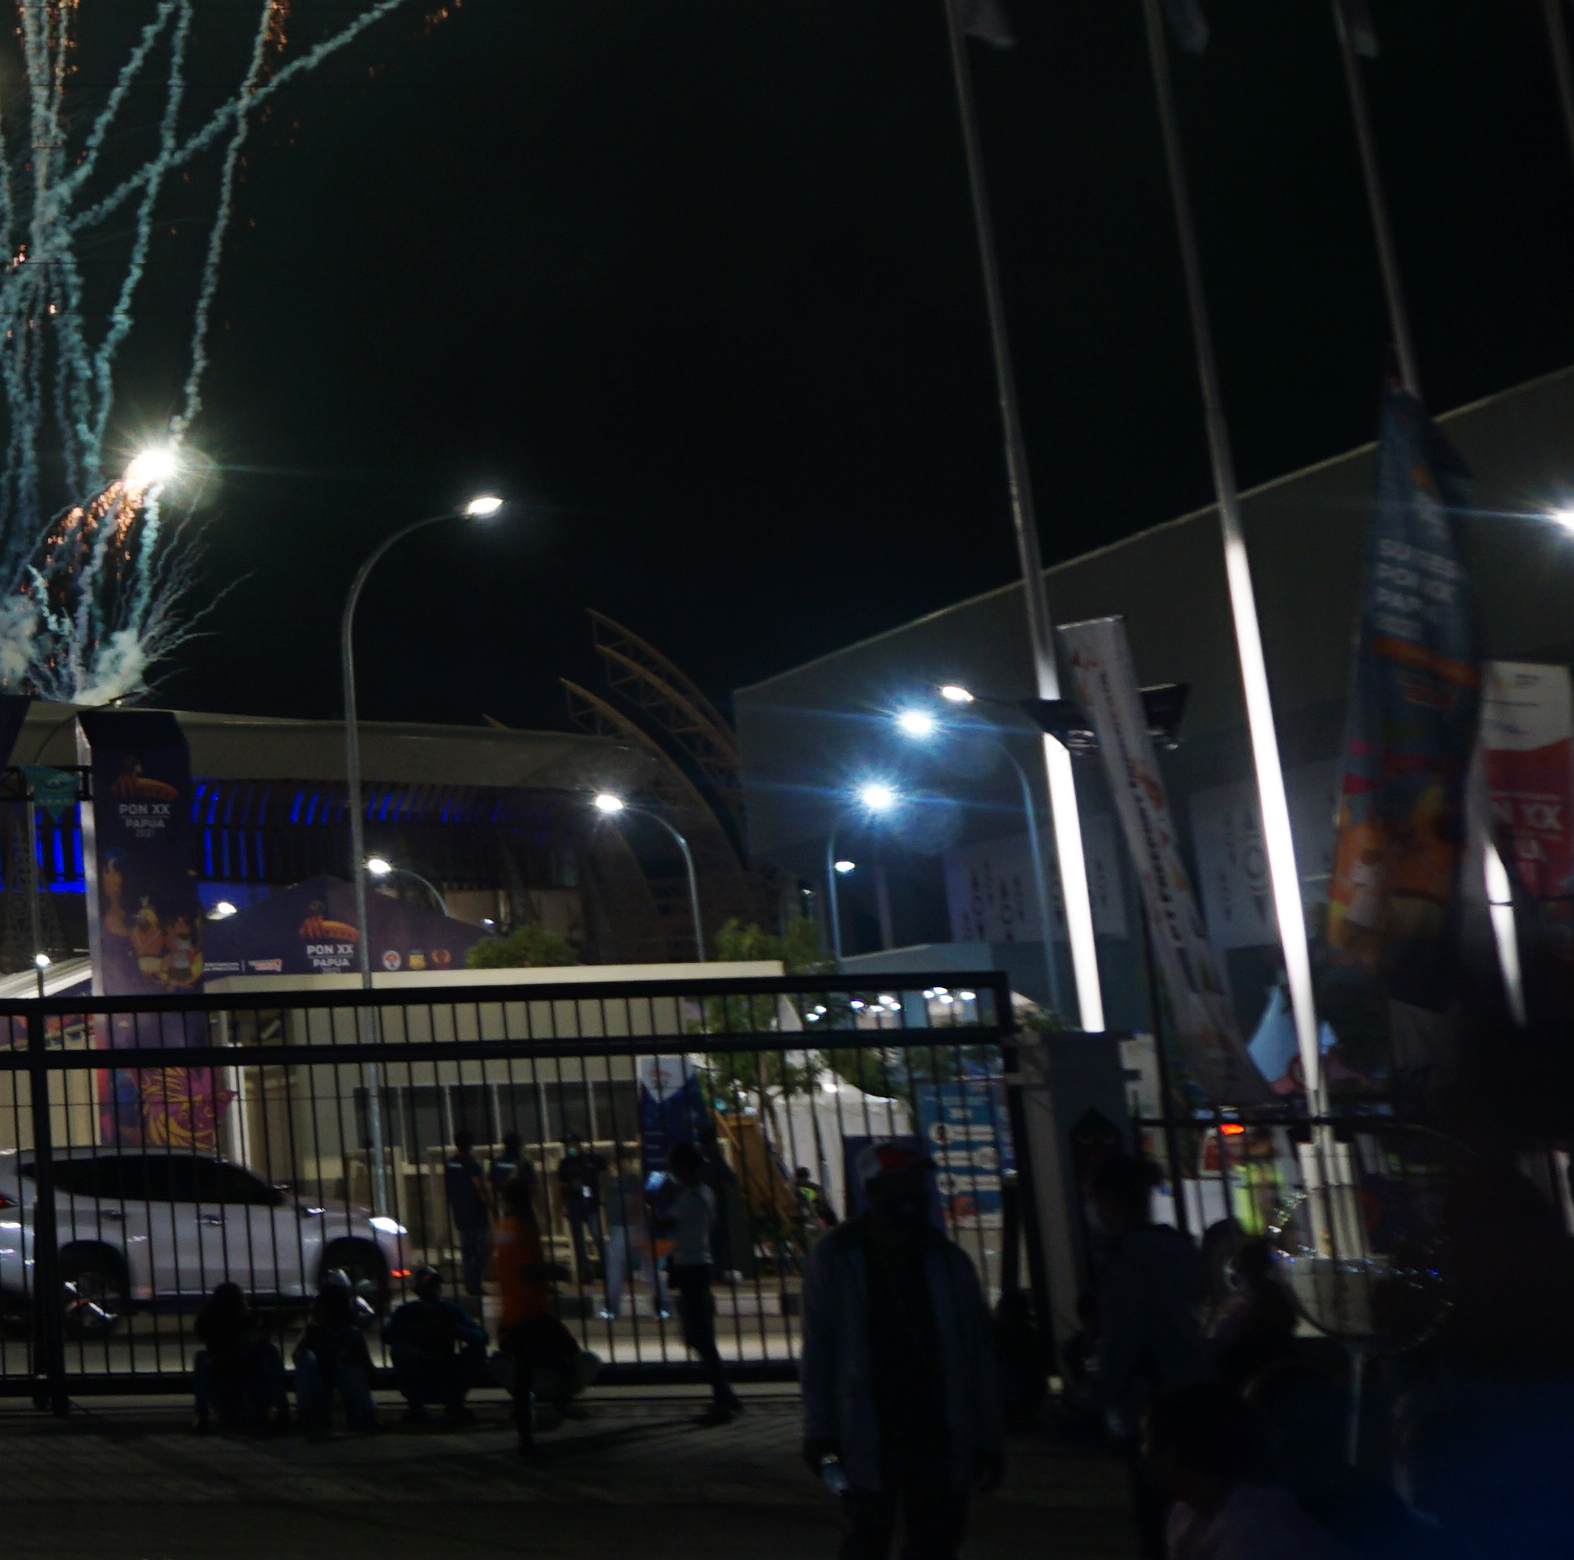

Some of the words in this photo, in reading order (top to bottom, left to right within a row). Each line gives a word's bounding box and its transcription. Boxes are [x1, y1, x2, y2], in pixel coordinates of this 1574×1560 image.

[307, 944, 334, 955] PON
[337, 944, 353, 954] XX
[313, 958, 351, 968] PAPUA
